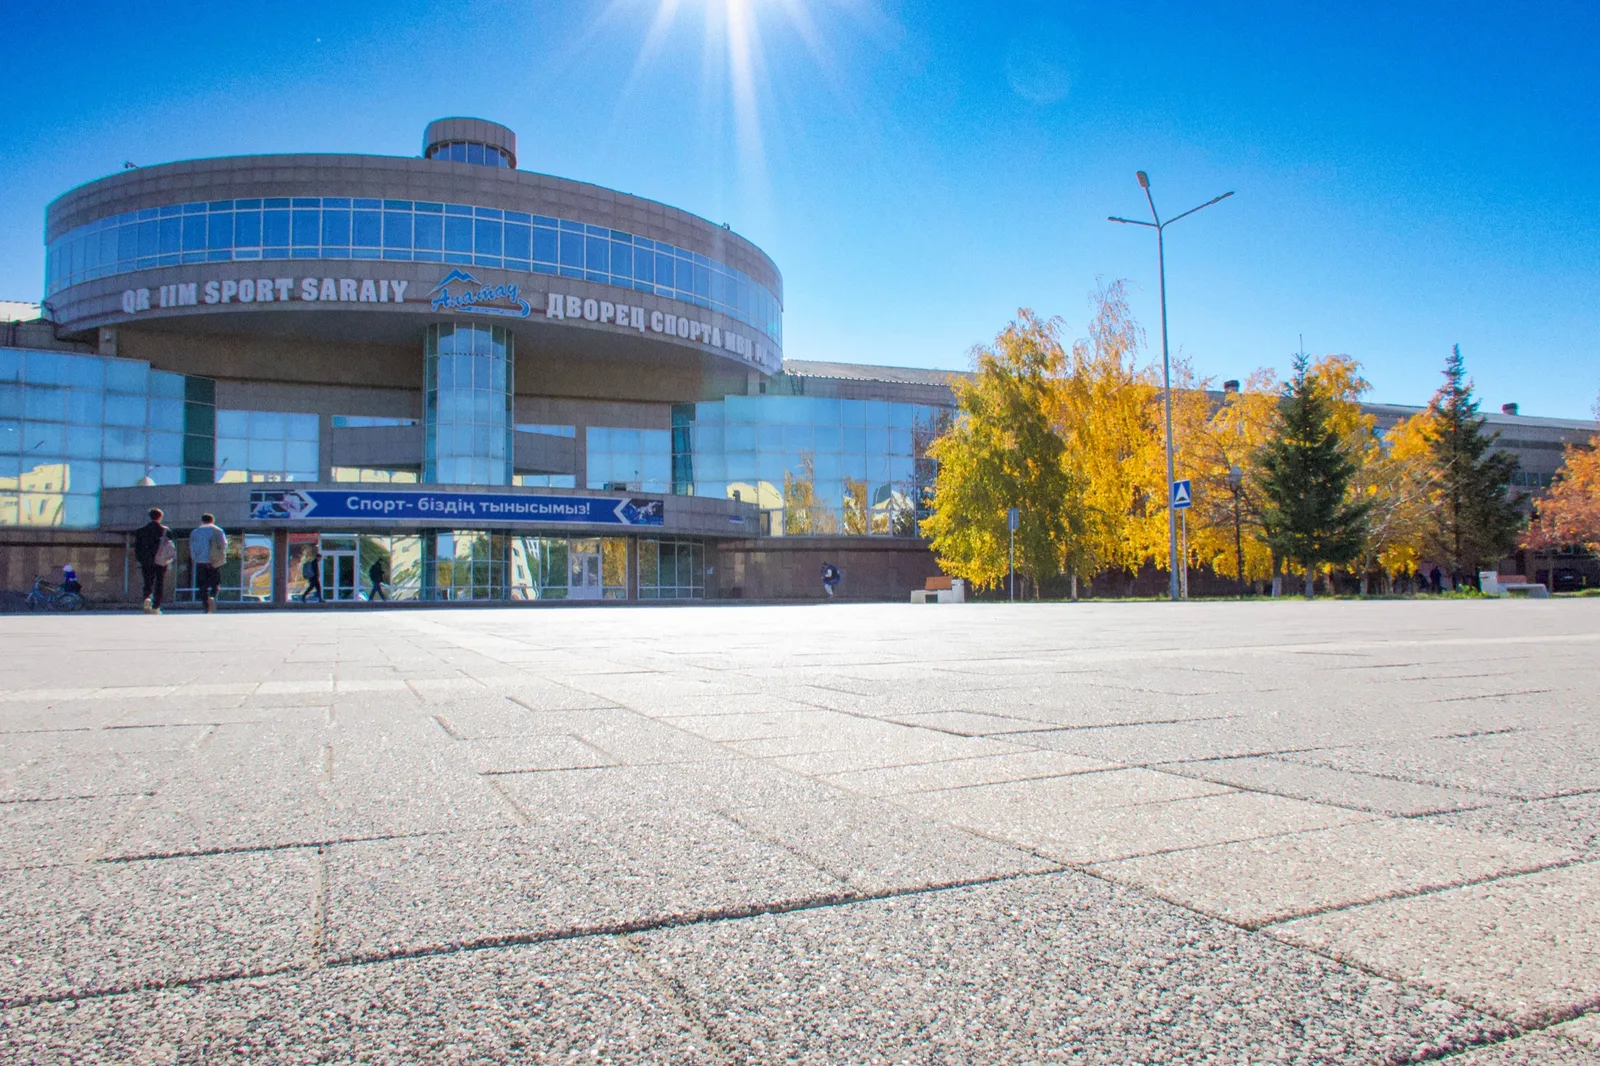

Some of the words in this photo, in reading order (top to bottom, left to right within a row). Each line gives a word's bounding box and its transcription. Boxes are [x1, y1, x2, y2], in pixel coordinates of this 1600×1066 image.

[122, 288, 150, 314] QR
[160, 283, 197, 307] IIM
[205, 278, 294, 304] SPORT
[301, 278, 408, 303] SARAIY
[431, 283, 519, 312] Алатау
[546, 292, 646, 333] ДВОРЕЦ
[651, 310, 722, 348] СПОРТА
[724, 328, 752, 362] МВД
[346, 496, 413, 514] Спорт-
[418, 497, 475, 514] біздің
[479, 502, 591, 516] тынысымыз!
